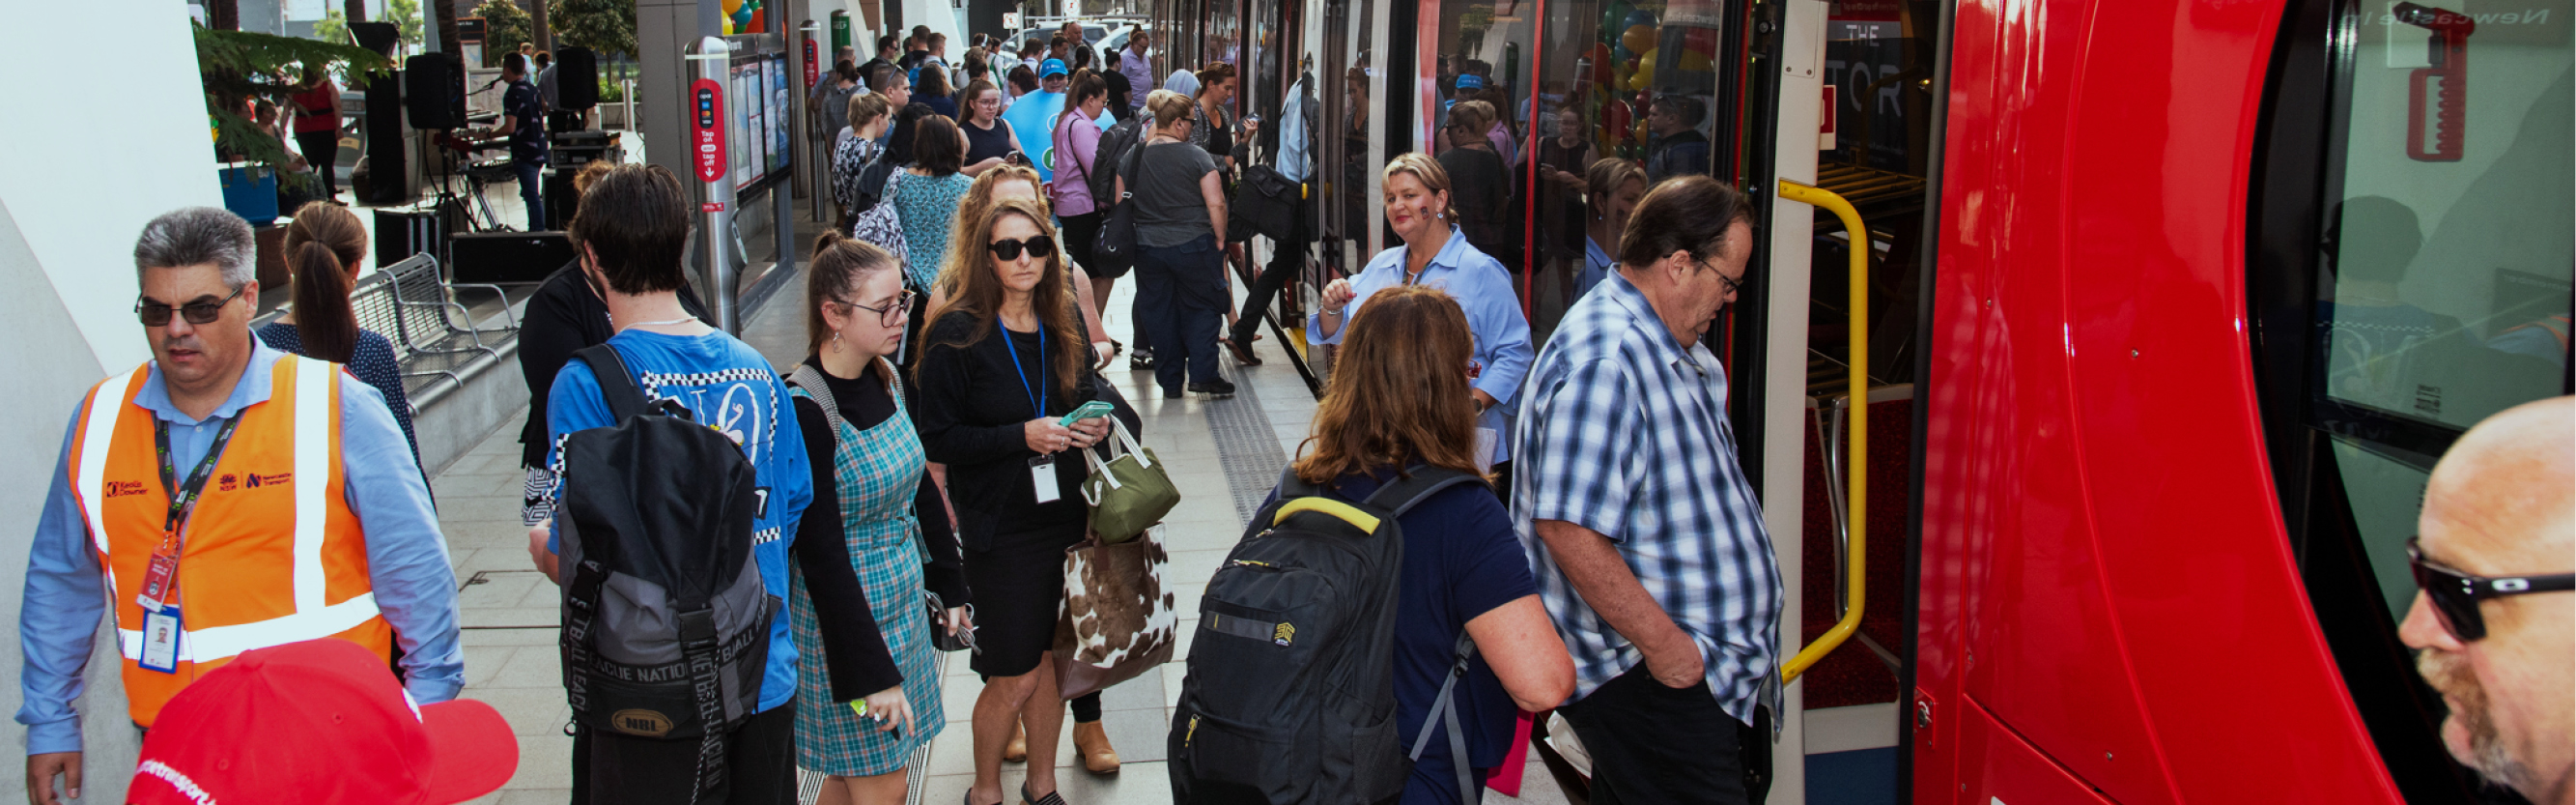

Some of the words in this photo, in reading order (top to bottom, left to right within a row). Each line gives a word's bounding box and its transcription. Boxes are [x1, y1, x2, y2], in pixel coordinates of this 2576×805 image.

[1846, 24, 1880, 47] THE
[701, 130, 715, 139] Tap
[637, 662, 689, 682] NATIO
[625, 716, 659, 733] NBL
